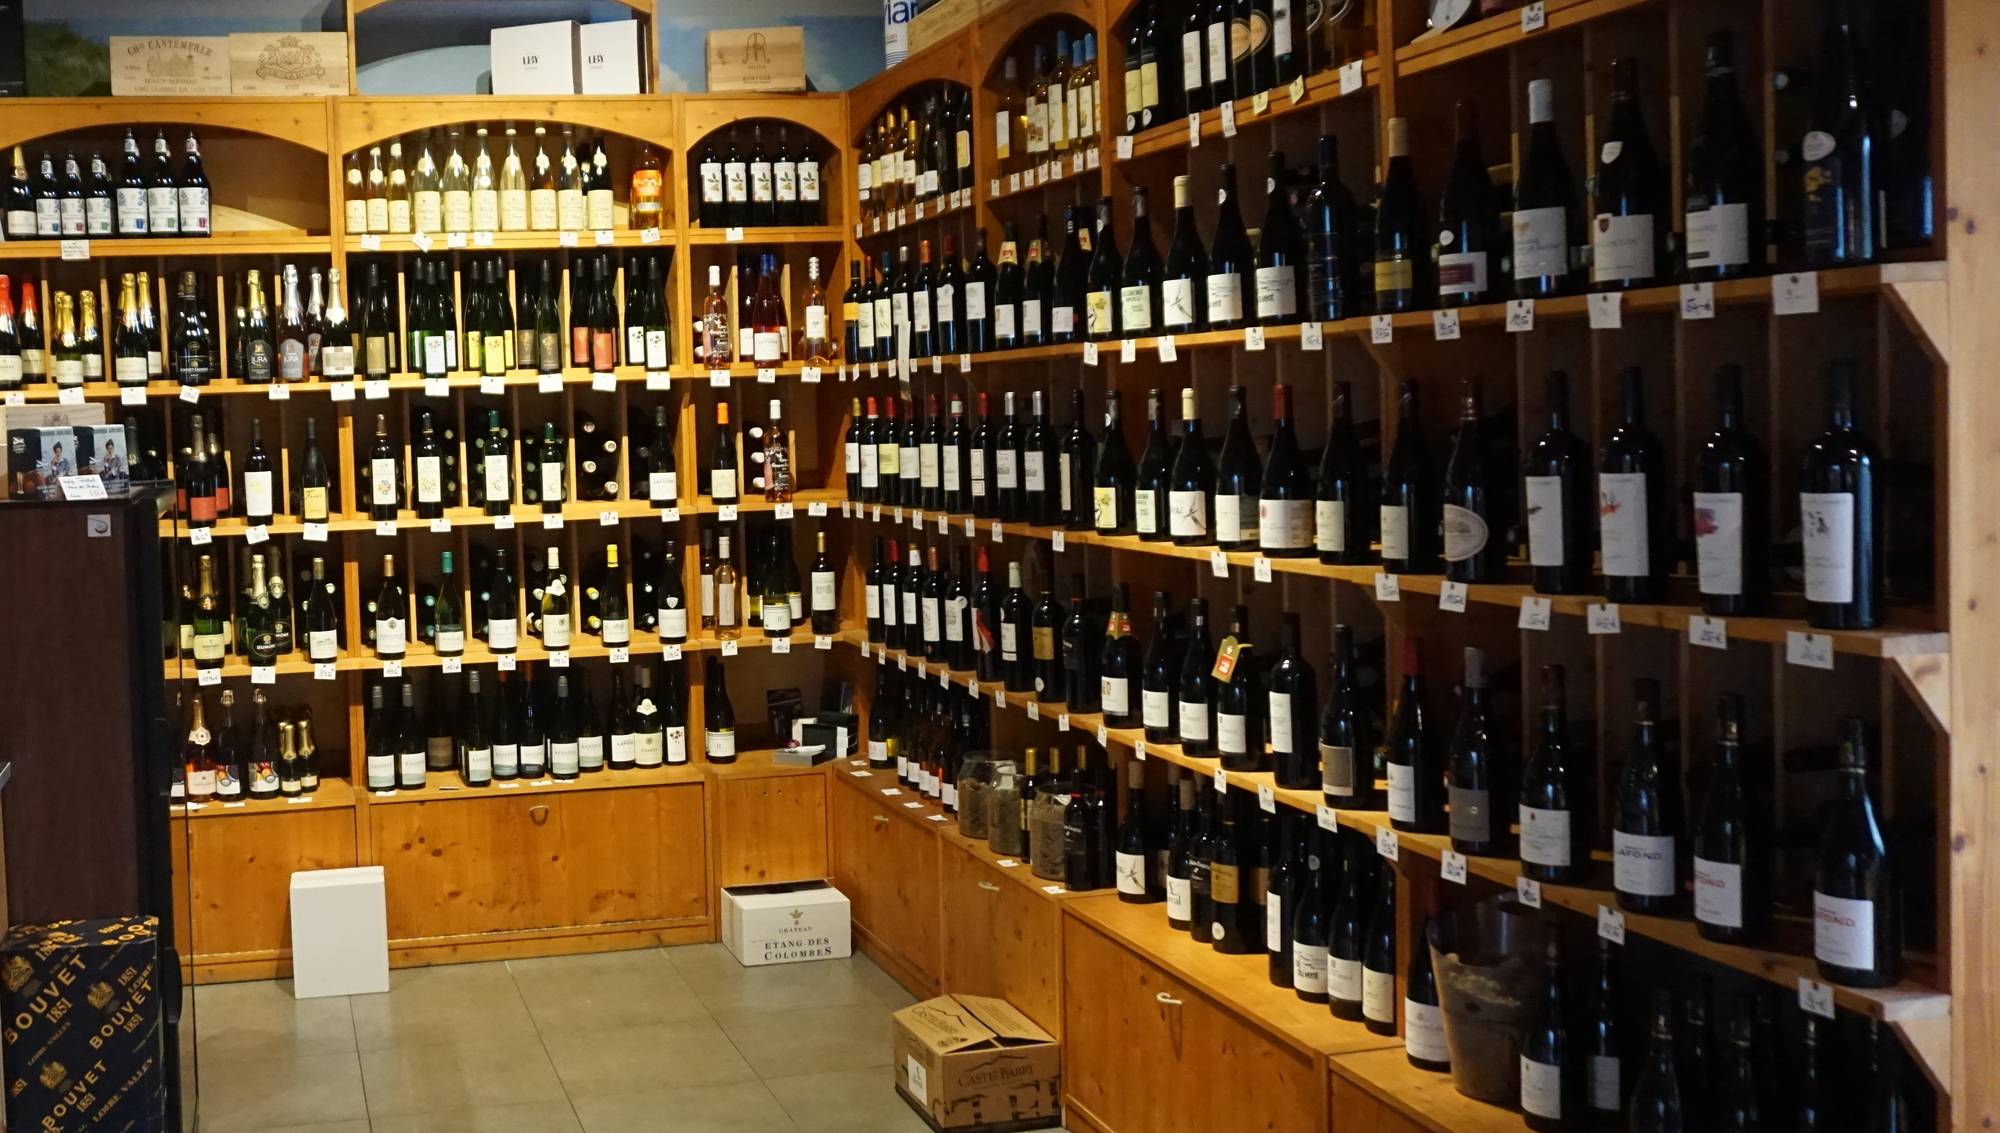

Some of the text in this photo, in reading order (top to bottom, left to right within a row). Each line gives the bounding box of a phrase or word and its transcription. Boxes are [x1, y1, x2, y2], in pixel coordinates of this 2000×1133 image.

[764, 937, 830, 950] ETANG DES
[764, 946, 832, 961] COLOMBES
[5, 954, 87, 1045] BOUVET
[46, 998, 73, 1024] 1851
[89, 979, 152, 1049] BOUVET
[41, 1059, 107, 1131] BOUVET
